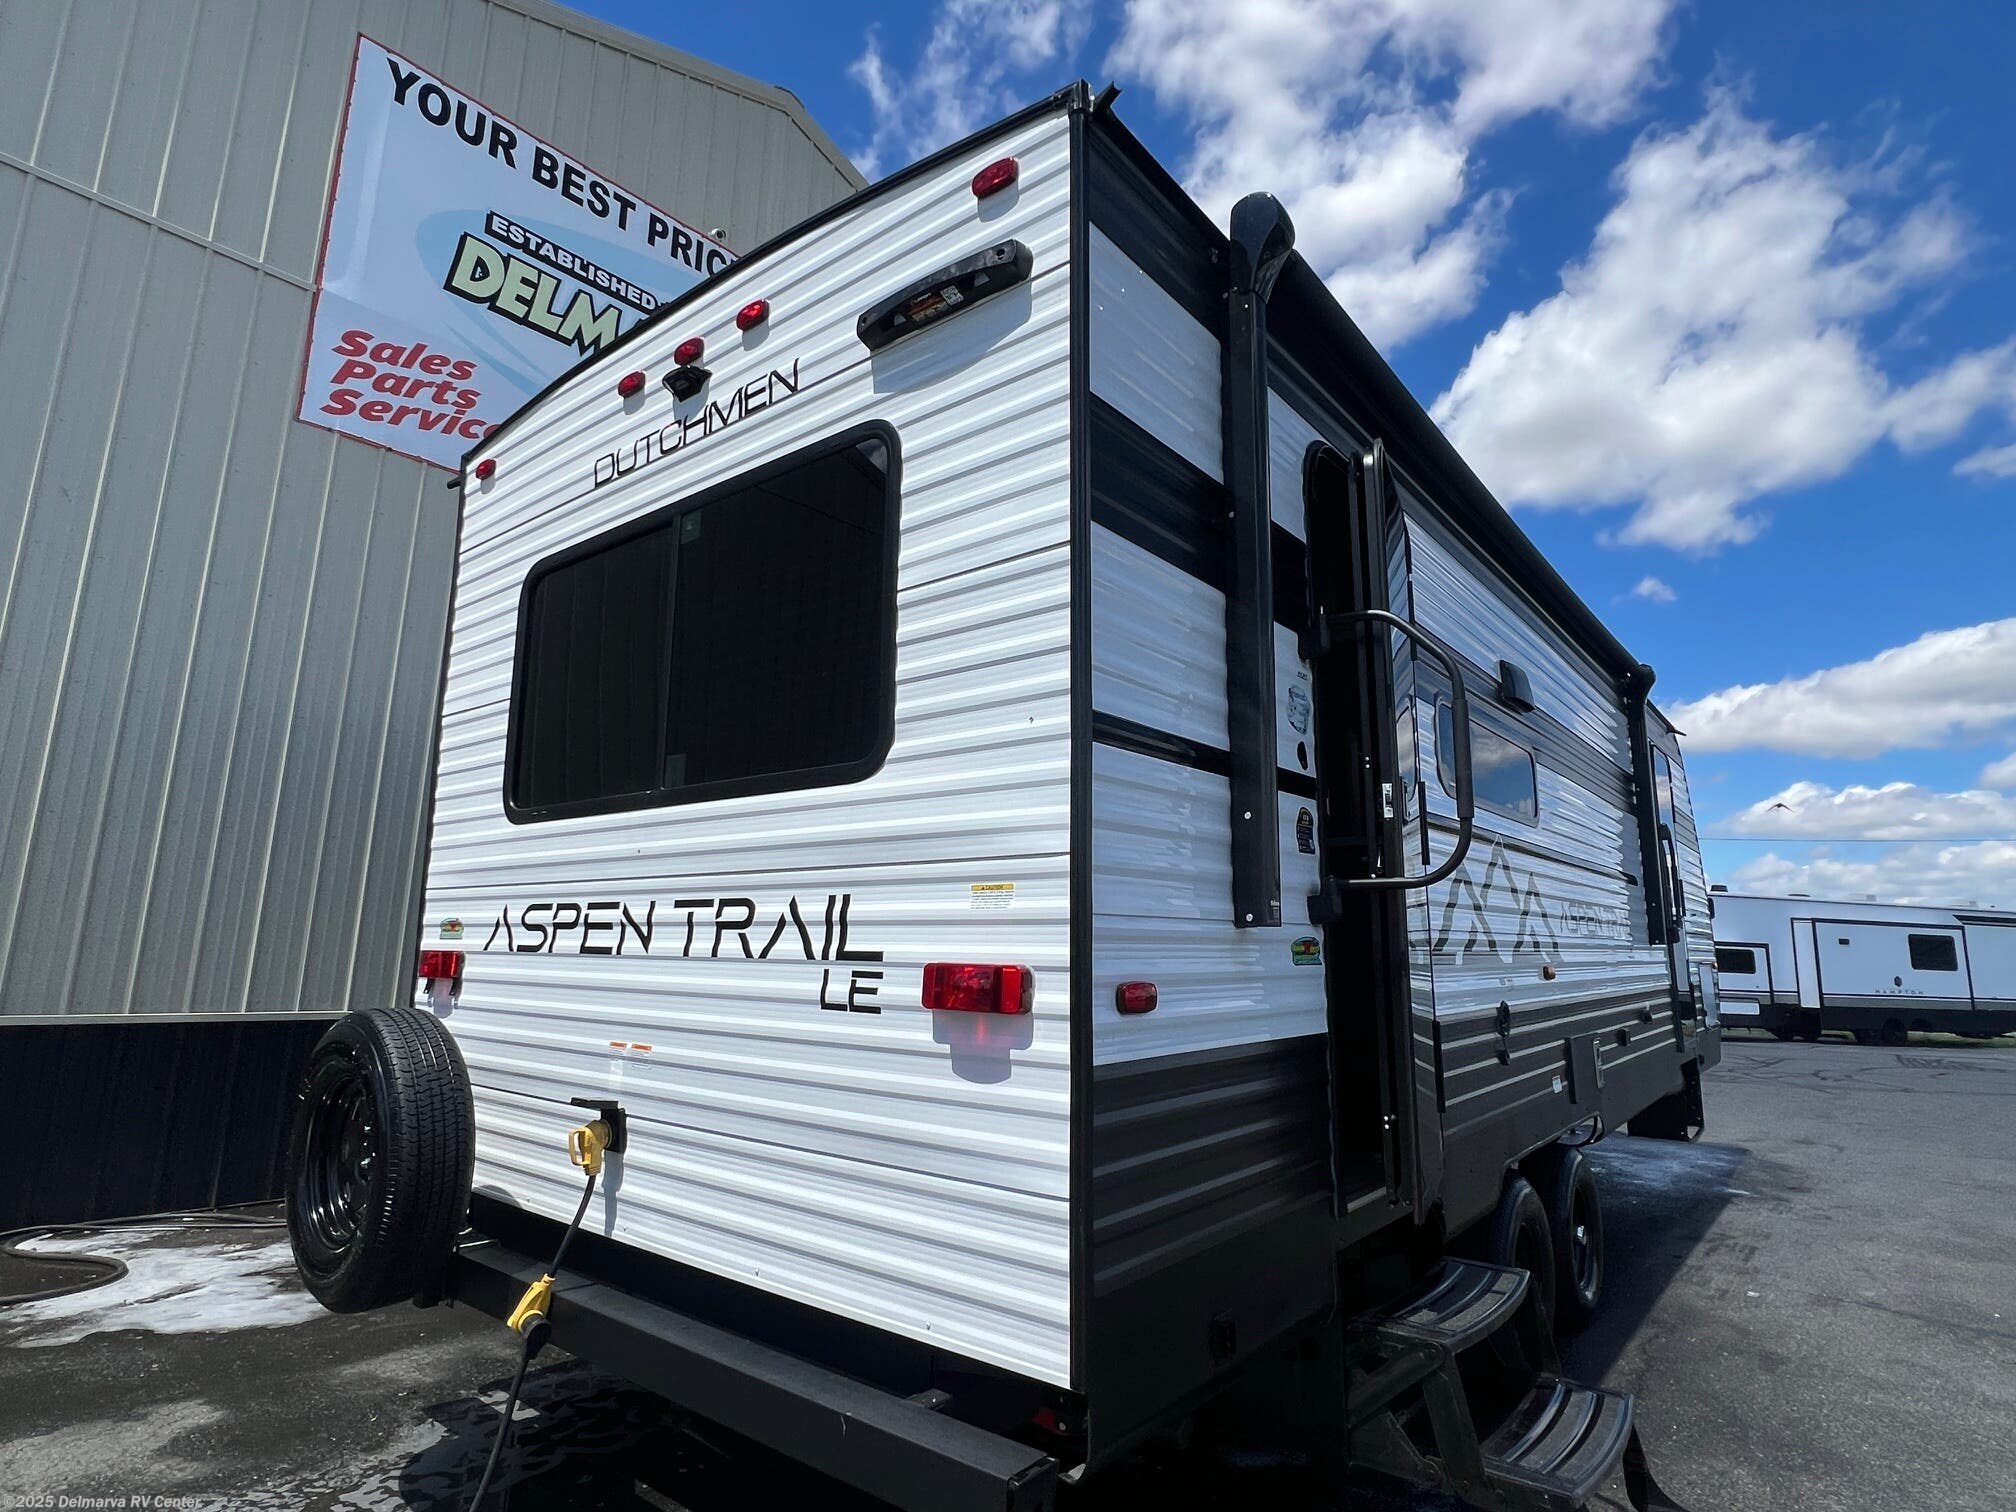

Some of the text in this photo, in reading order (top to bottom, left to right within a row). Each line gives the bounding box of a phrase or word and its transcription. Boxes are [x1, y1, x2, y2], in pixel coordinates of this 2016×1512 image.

[387, 57, 736, 277] YOUR BEST PRIC
[446, 234, 622, 353] DELM
[490, 215, 656, 311] ESTABLISHED
[330, 359, 480, 409] Parts
[332, 330, 477, 380] Sales
[594, 358, 799, 489] DUTCHMEN
[483, 894, 884, 962] ASPEN TRAIL
[820, 969, 884, 1014] LE
